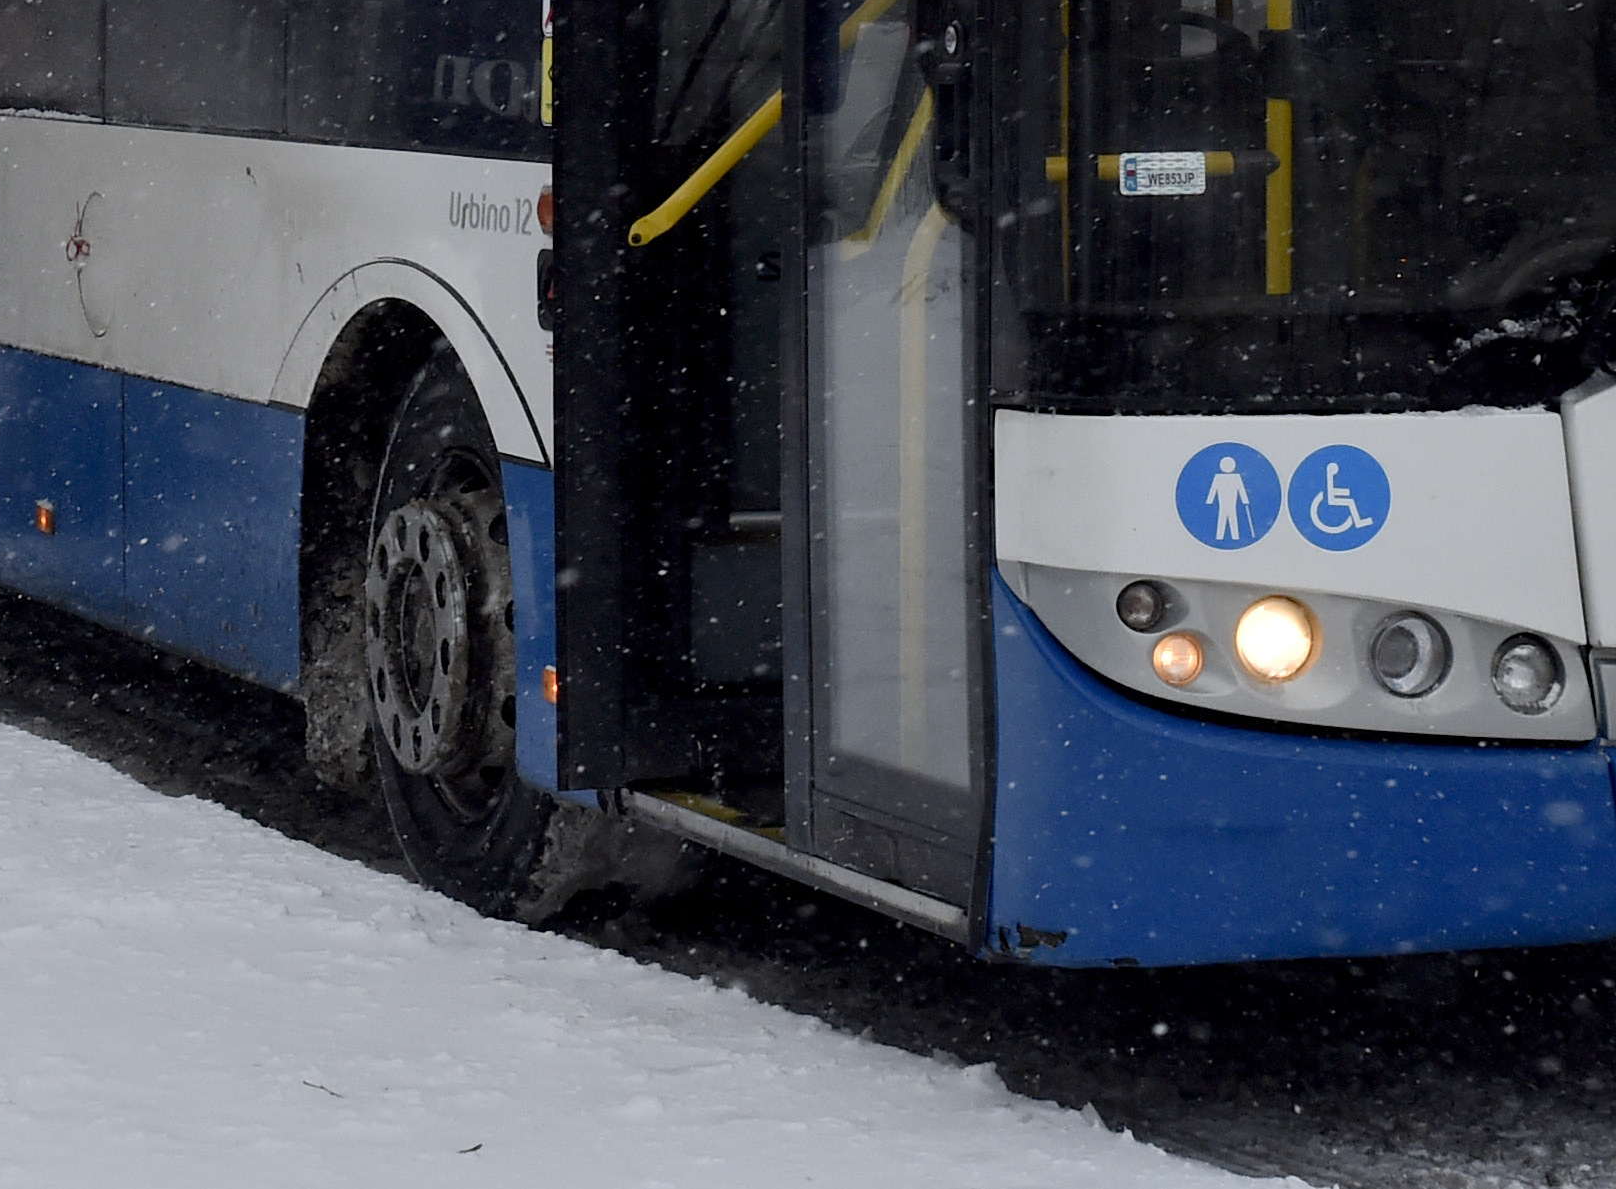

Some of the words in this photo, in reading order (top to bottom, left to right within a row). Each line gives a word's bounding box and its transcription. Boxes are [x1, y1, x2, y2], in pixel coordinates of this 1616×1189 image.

[1147, 172, 1196, 185] WE853JP
[448, 190, 511, 234] Urbino
[515, 196, 534, 237] 12
